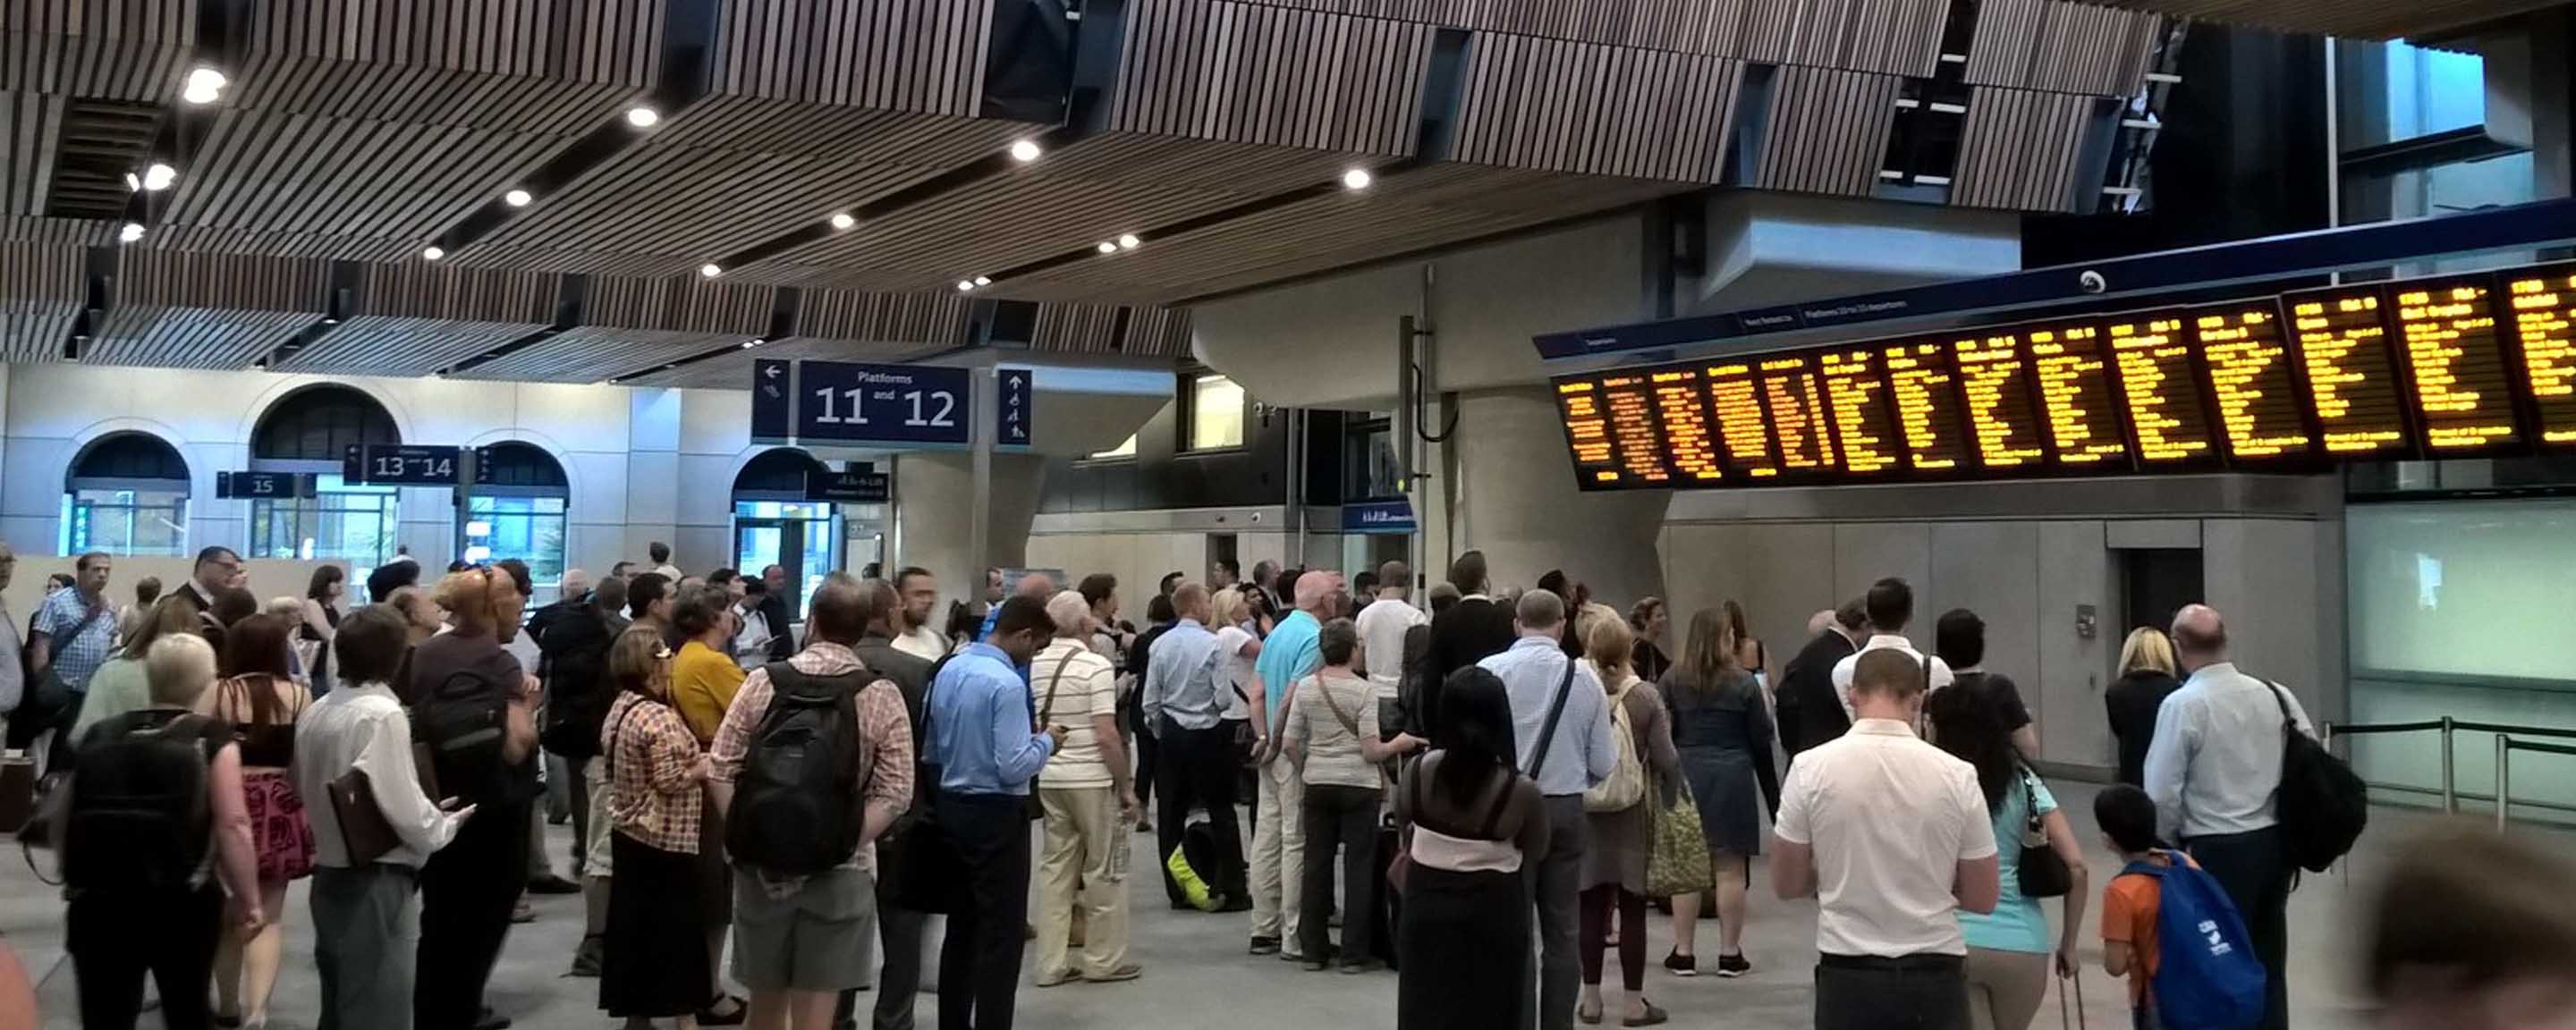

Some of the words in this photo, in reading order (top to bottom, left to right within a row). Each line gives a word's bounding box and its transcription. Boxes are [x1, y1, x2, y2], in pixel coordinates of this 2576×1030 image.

[858, 372, 912, 384] Platforms
[816, 386, 868, 424] 11
[874, 391, 894, 400] and
[904, 391, 953, 426] 12
[377, 457, 404, 476] 13
[422, 459, 453, 477] 14
[252, 480, 274, 493] 15
